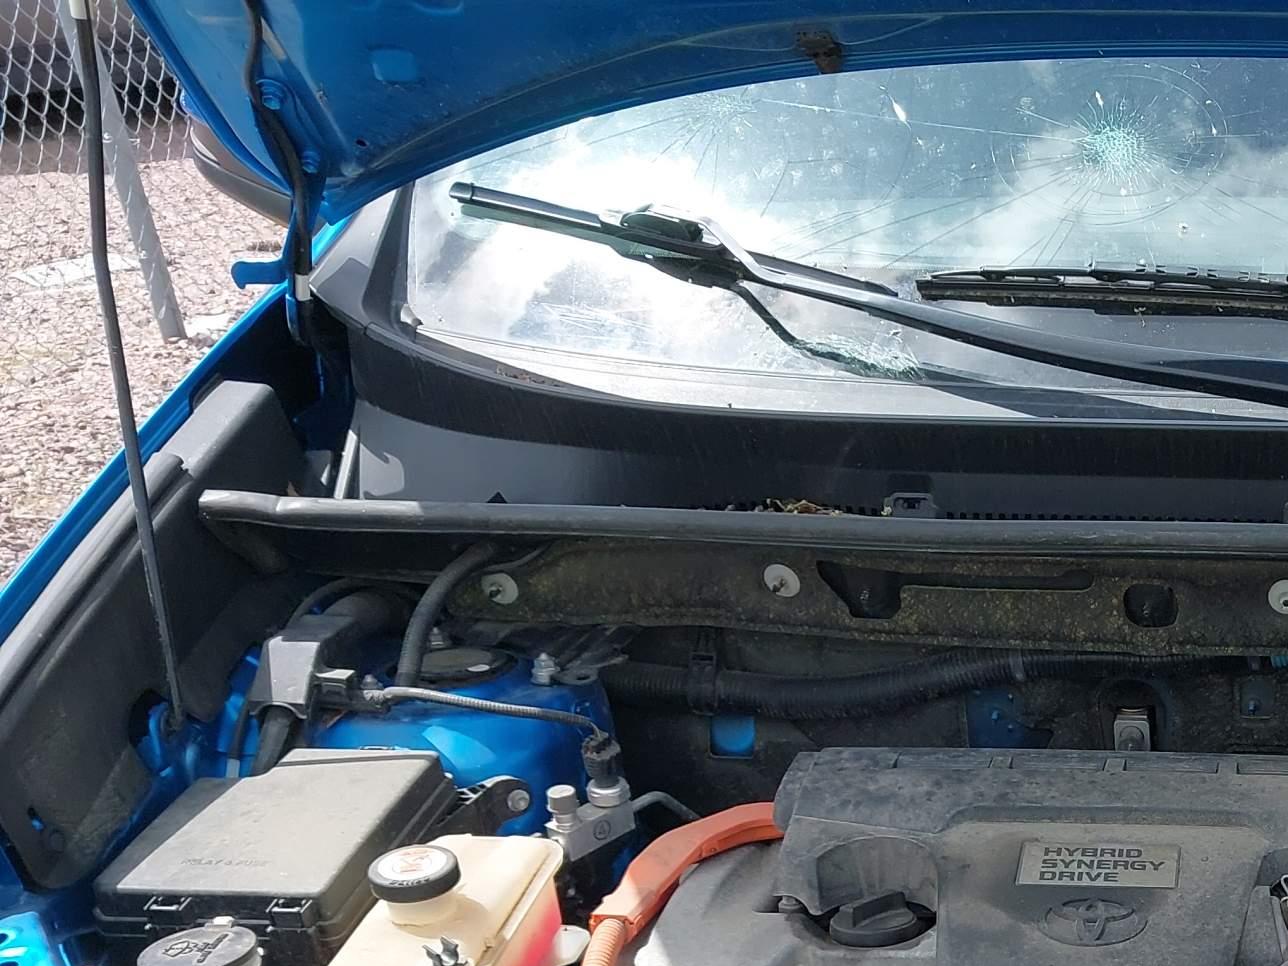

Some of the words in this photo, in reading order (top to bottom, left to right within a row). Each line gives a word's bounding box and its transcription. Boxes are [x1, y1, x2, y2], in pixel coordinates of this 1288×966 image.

[1043, 847, 1143, 859] HYBRID
[1041, 858, 1166, 872] SYNERGY
[1039, 871, 1121, 882] DRIVE
